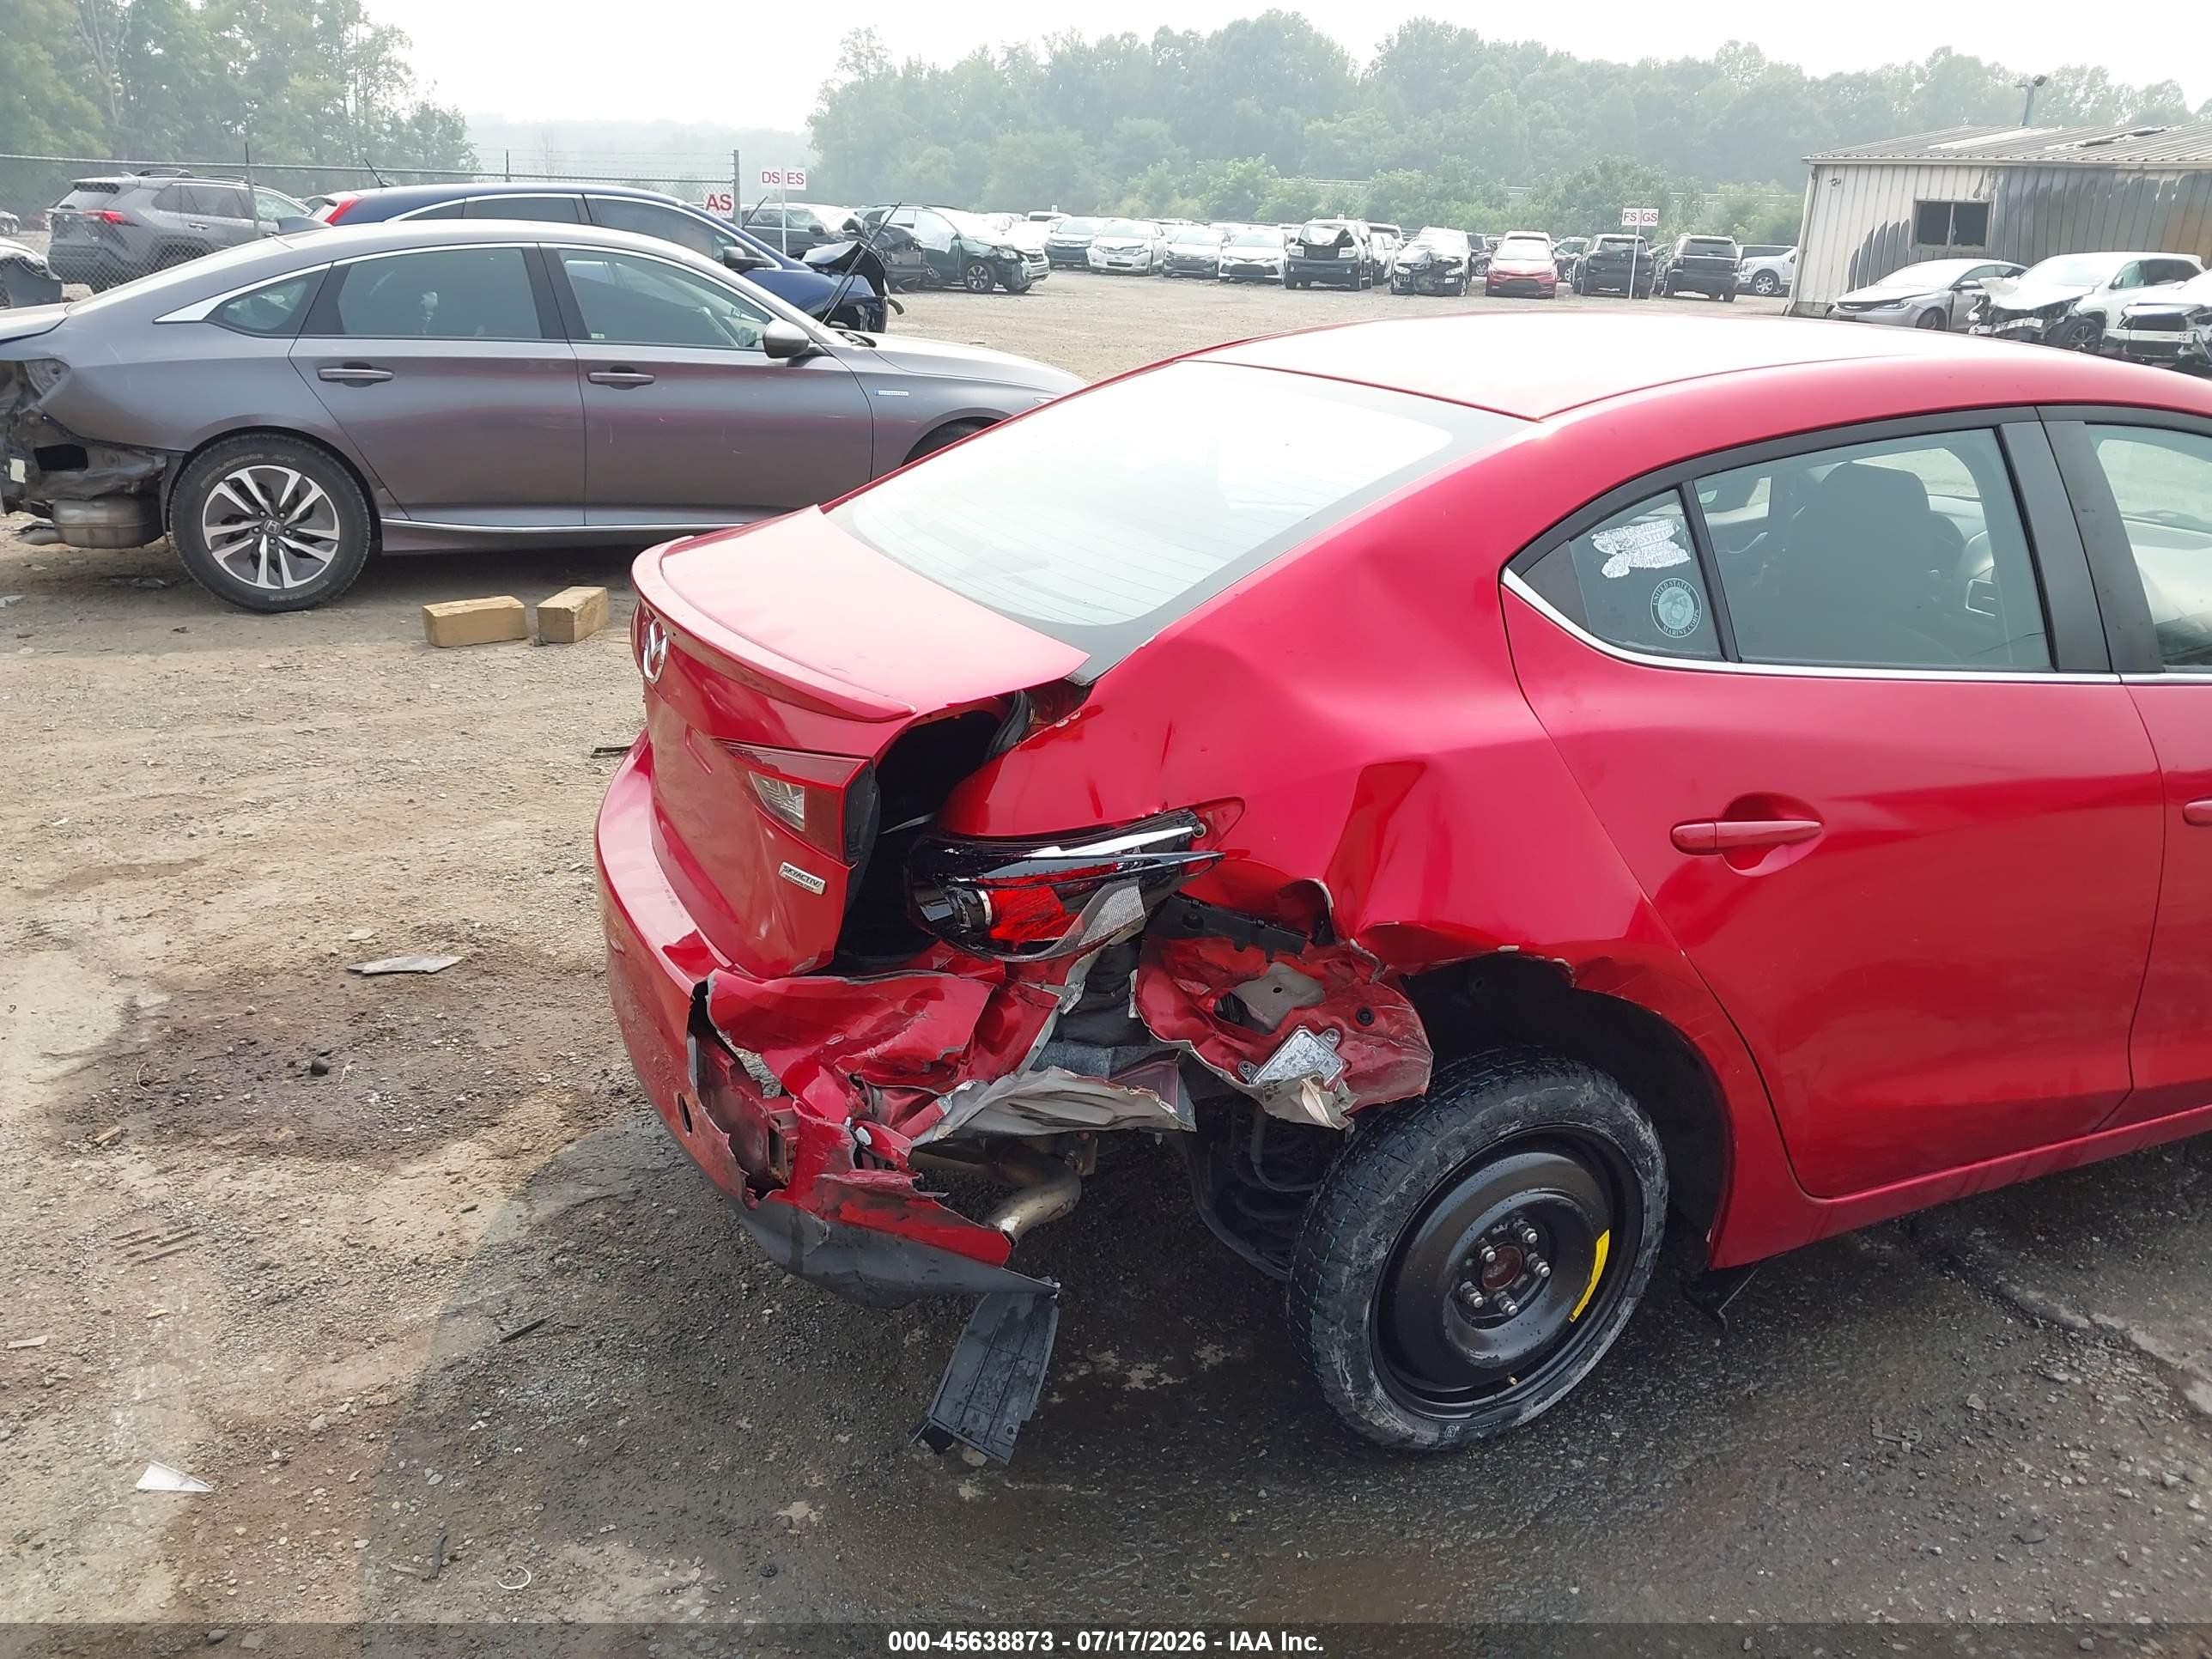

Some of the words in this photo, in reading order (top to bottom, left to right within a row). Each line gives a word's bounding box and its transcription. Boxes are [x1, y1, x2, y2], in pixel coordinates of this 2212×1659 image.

[762, 171, 781, 184] DS
[787, 172, 805, 185] ES
[705, 193, 732, 211] AS
[1623, 211, 1638, 222] FS
[1642, 212, 1657, 222] GS
[1652, 582, 1668, 605] UNITED
[1662, 624, 1686, 636] MARINE
[1686, 609, 1699, 631] CORPS
